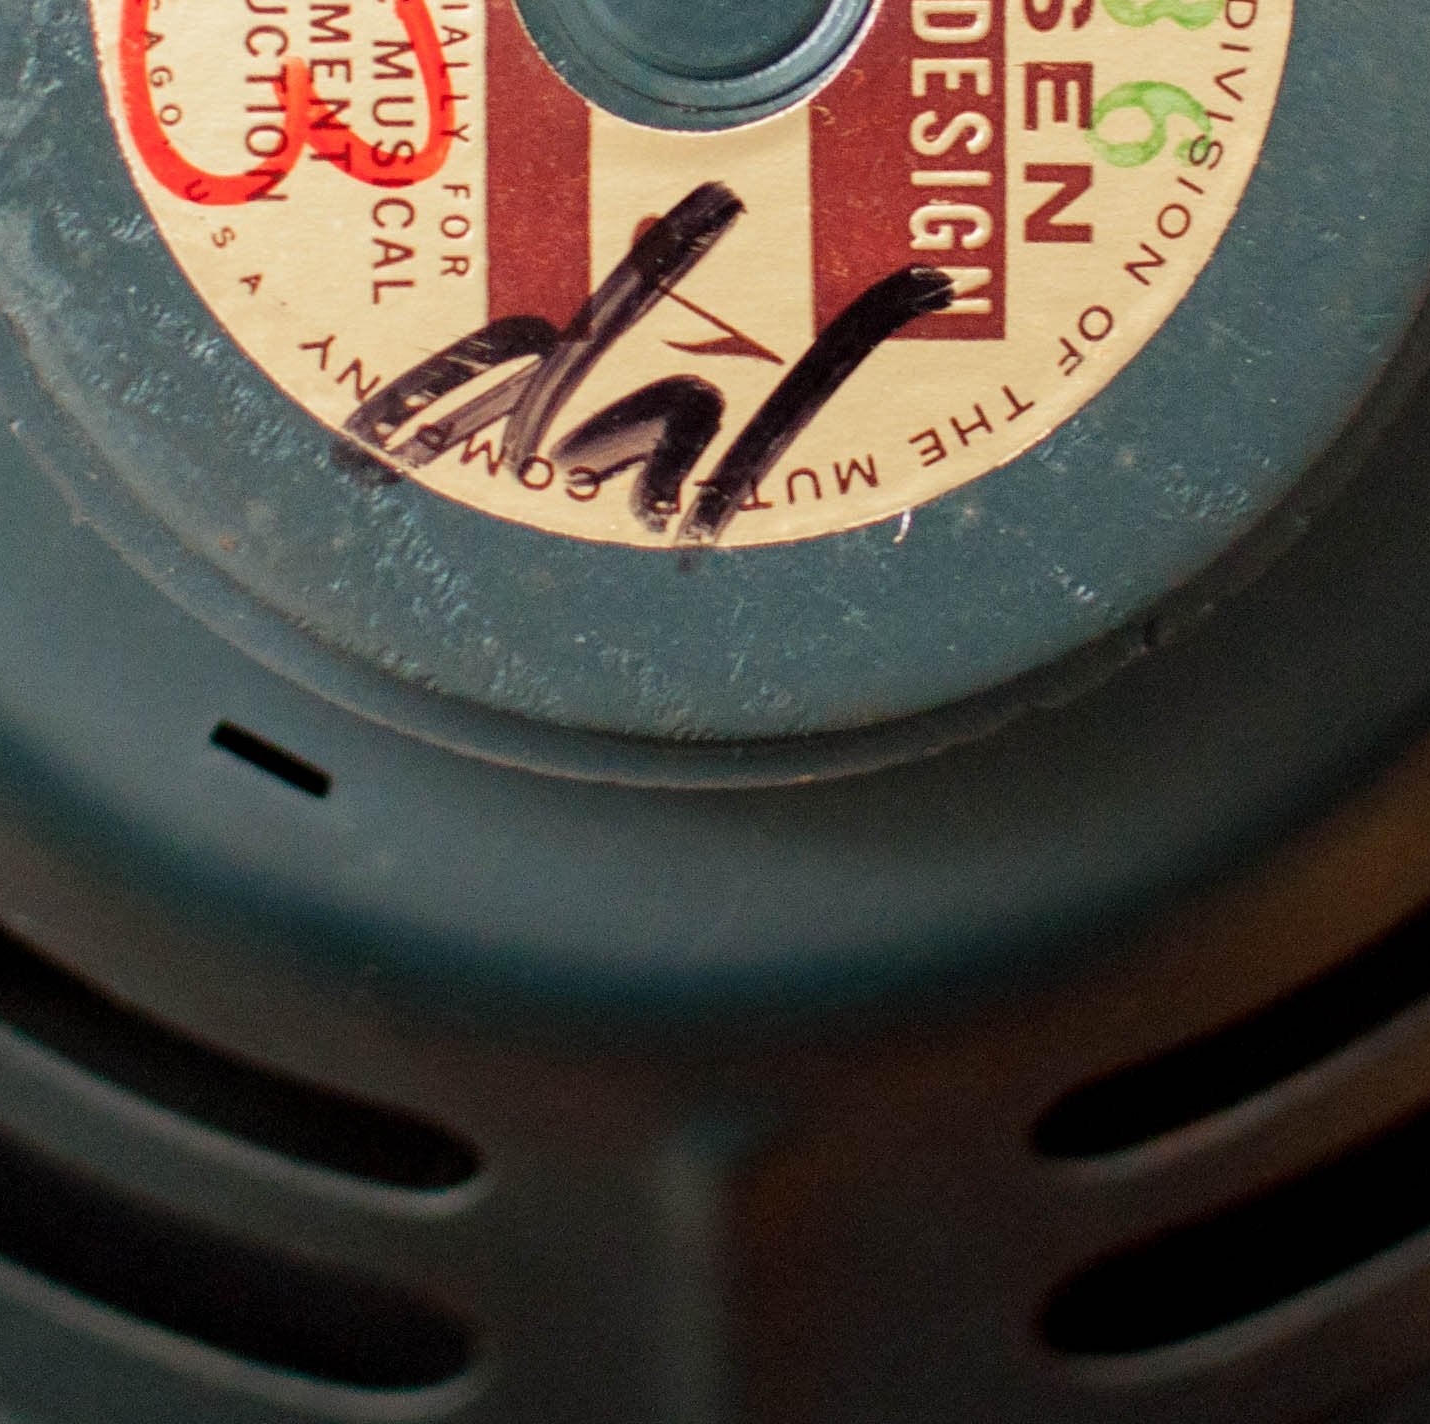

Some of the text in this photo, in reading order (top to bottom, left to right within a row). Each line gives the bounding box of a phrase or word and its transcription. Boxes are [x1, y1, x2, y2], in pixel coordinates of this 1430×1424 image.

[371, 40, 415, 305] MUSICAL
[440, 184, 470, 278] FOR
[1057, 305, 1114, 376] OF
[299, 334, 600, 502] COMPNY
[908, 384, 1035, 467] THE
